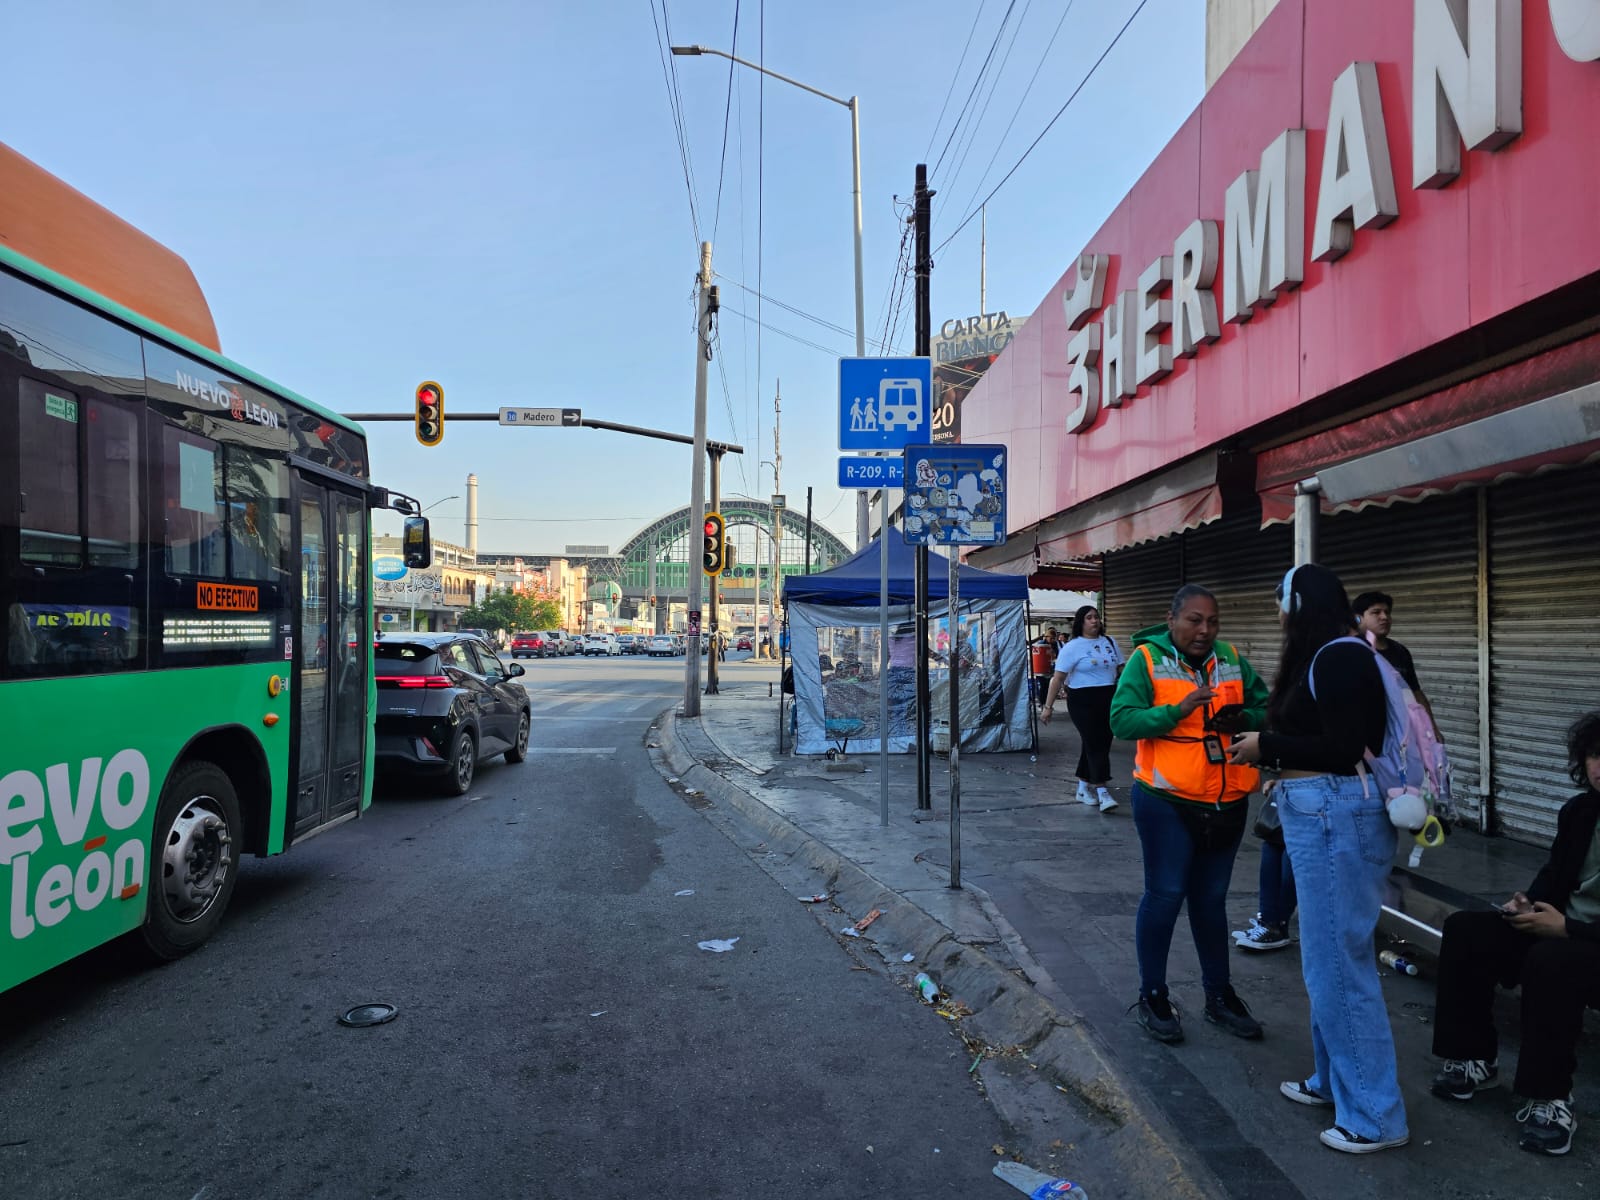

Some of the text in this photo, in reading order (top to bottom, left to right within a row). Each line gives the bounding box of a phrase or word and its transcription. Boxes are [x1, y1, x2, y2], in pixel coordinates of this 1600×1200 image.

[941, 310, 1012, 340] CARTA
[176, 369, 230, 409] NUEVO
[523, 412, 555, 421] Madero
[889, 465, 904, 479] R-
[199, 586, 257, 608] NO EFECTIVO
